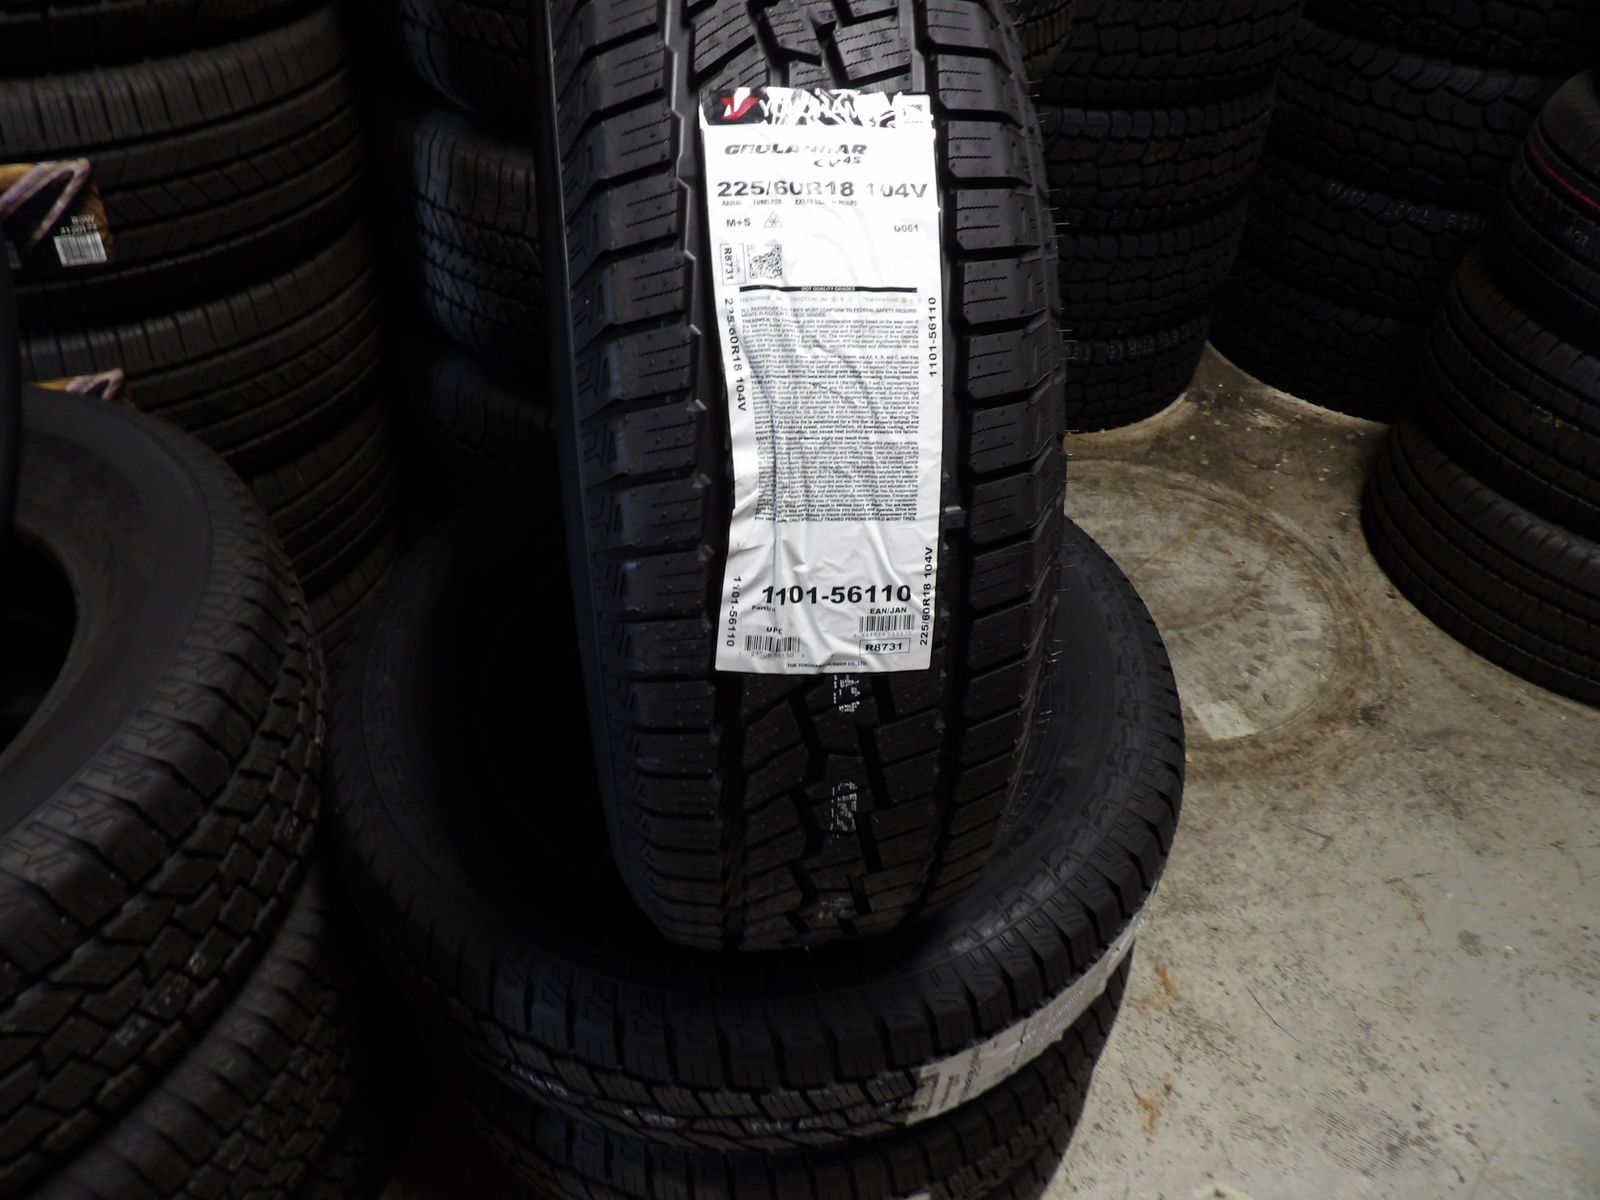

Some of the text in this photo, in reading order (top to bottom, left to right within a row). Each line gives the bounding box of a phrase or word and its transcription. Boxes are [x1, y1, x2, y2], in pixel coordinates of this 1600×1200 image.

[717, 181, 928, 198] 225/60R18 104V
[726, 218, 751, 227] M+S
[723, 247, 734, 280] R8731
[928, 297, 937, 377] 1101-56110
[735, 376, 747, 412] 104V
[726, 576, 742, 647] 1101-56110
[762, 584, 911, 606] 1101-56110
[920, 547, 934, 646] 225/60R18 104V
[865, 642, 902, 652] R8731
